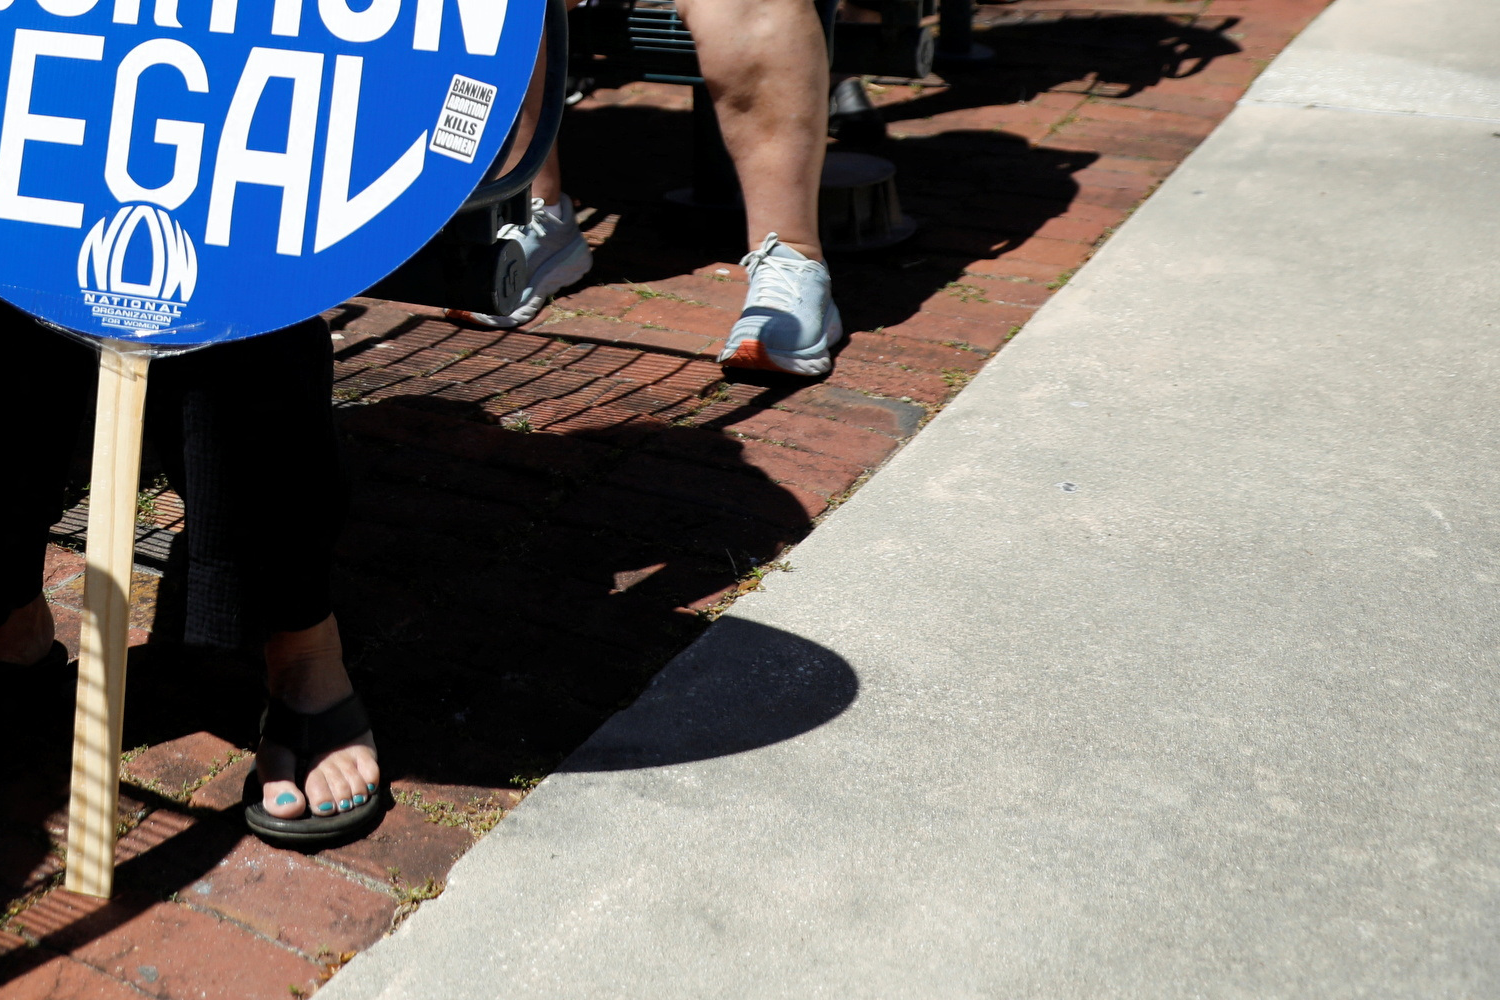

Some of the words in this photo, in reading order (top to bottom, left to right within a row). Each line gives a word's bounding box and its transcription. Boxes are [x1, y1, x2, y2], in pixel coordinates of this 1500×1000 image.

[452, 78, 493, 103] BANNING
[446, 94, 488, 120] ABORTION
[443, 114, 478, 136] KILLS
[434, 129, 476, 156] WOMEN
[77, 204, 198, 302] NOW
[84, 293, 182, 315] NATIONAL
[92, 305, 172, 323] ORGANIZATION
[101, 316, 121, 326] FOR
[123, 318, 160, 331] WOMEN
